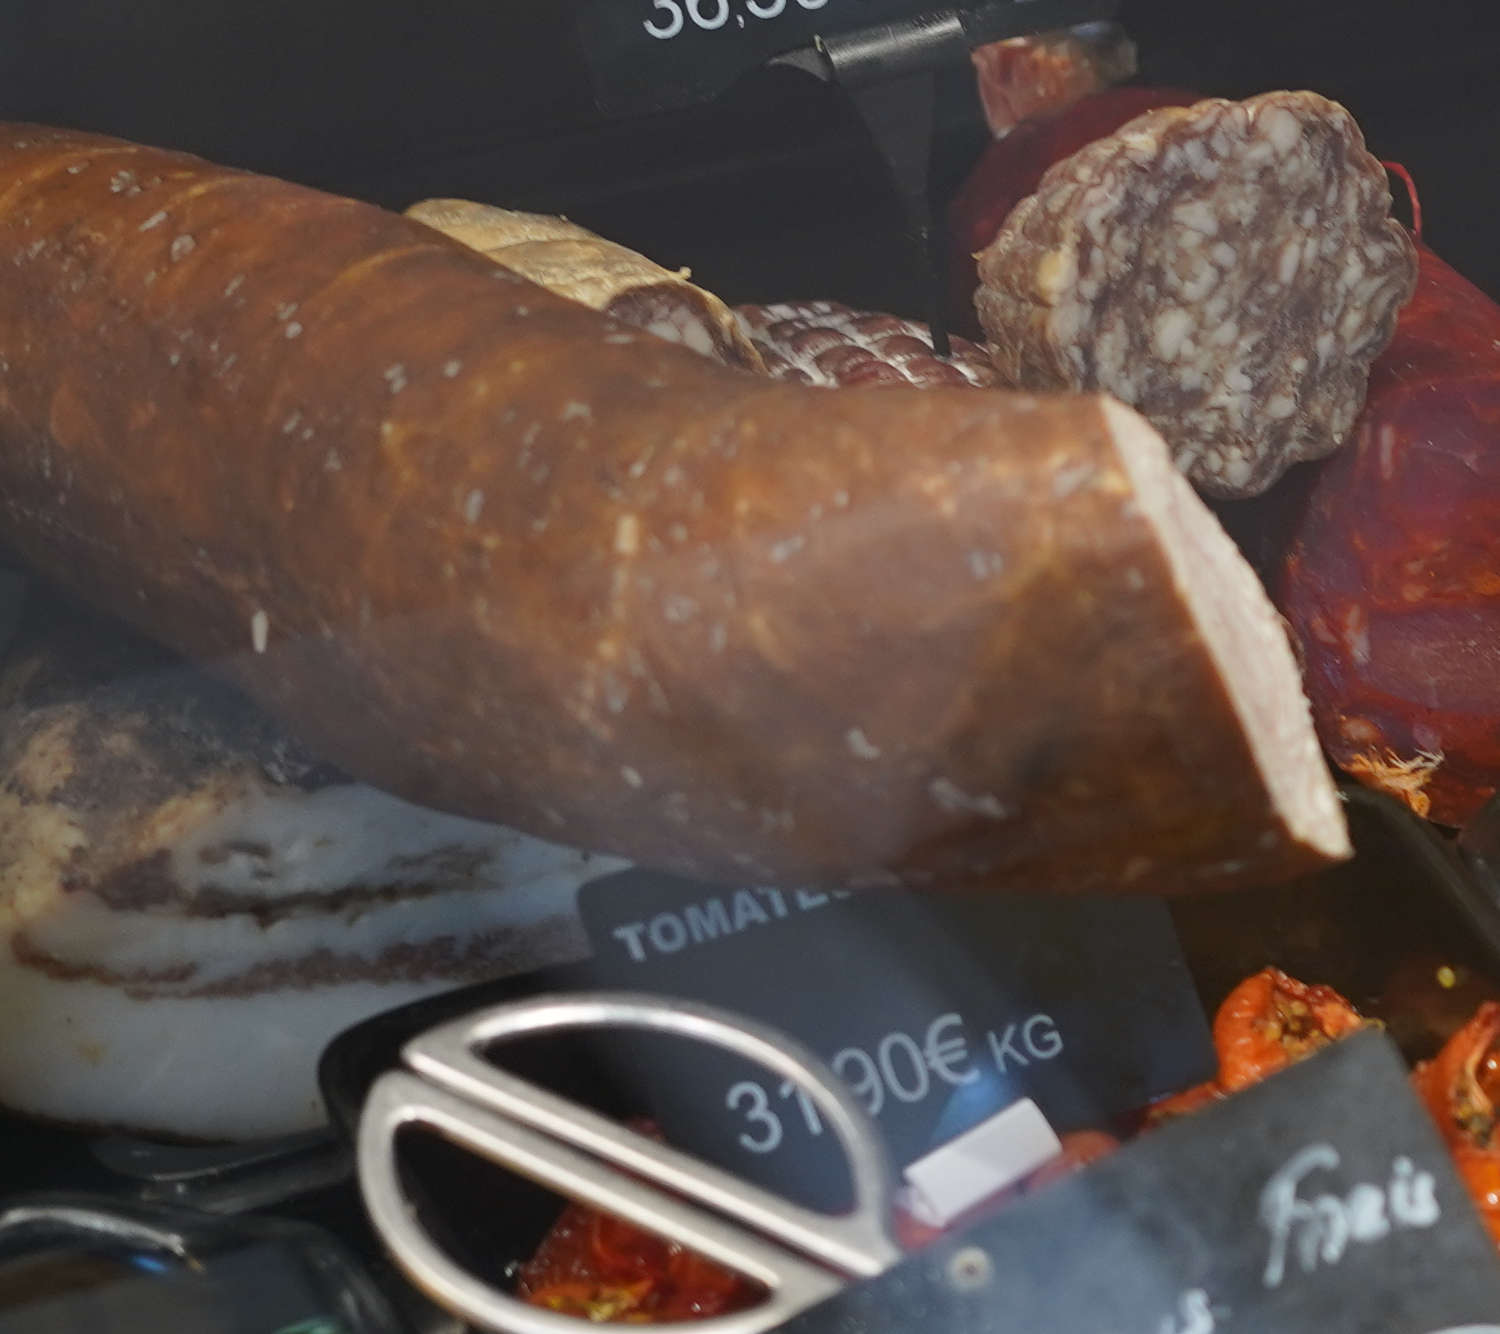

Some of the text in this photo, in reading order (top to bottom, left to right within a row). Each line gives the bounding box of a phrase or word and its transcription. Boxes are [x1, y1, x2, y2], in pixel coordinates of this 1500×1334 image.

[612, 886, 851, 963] TOMAT
[726, 1013, 1064, 1154] 3190€ KG
